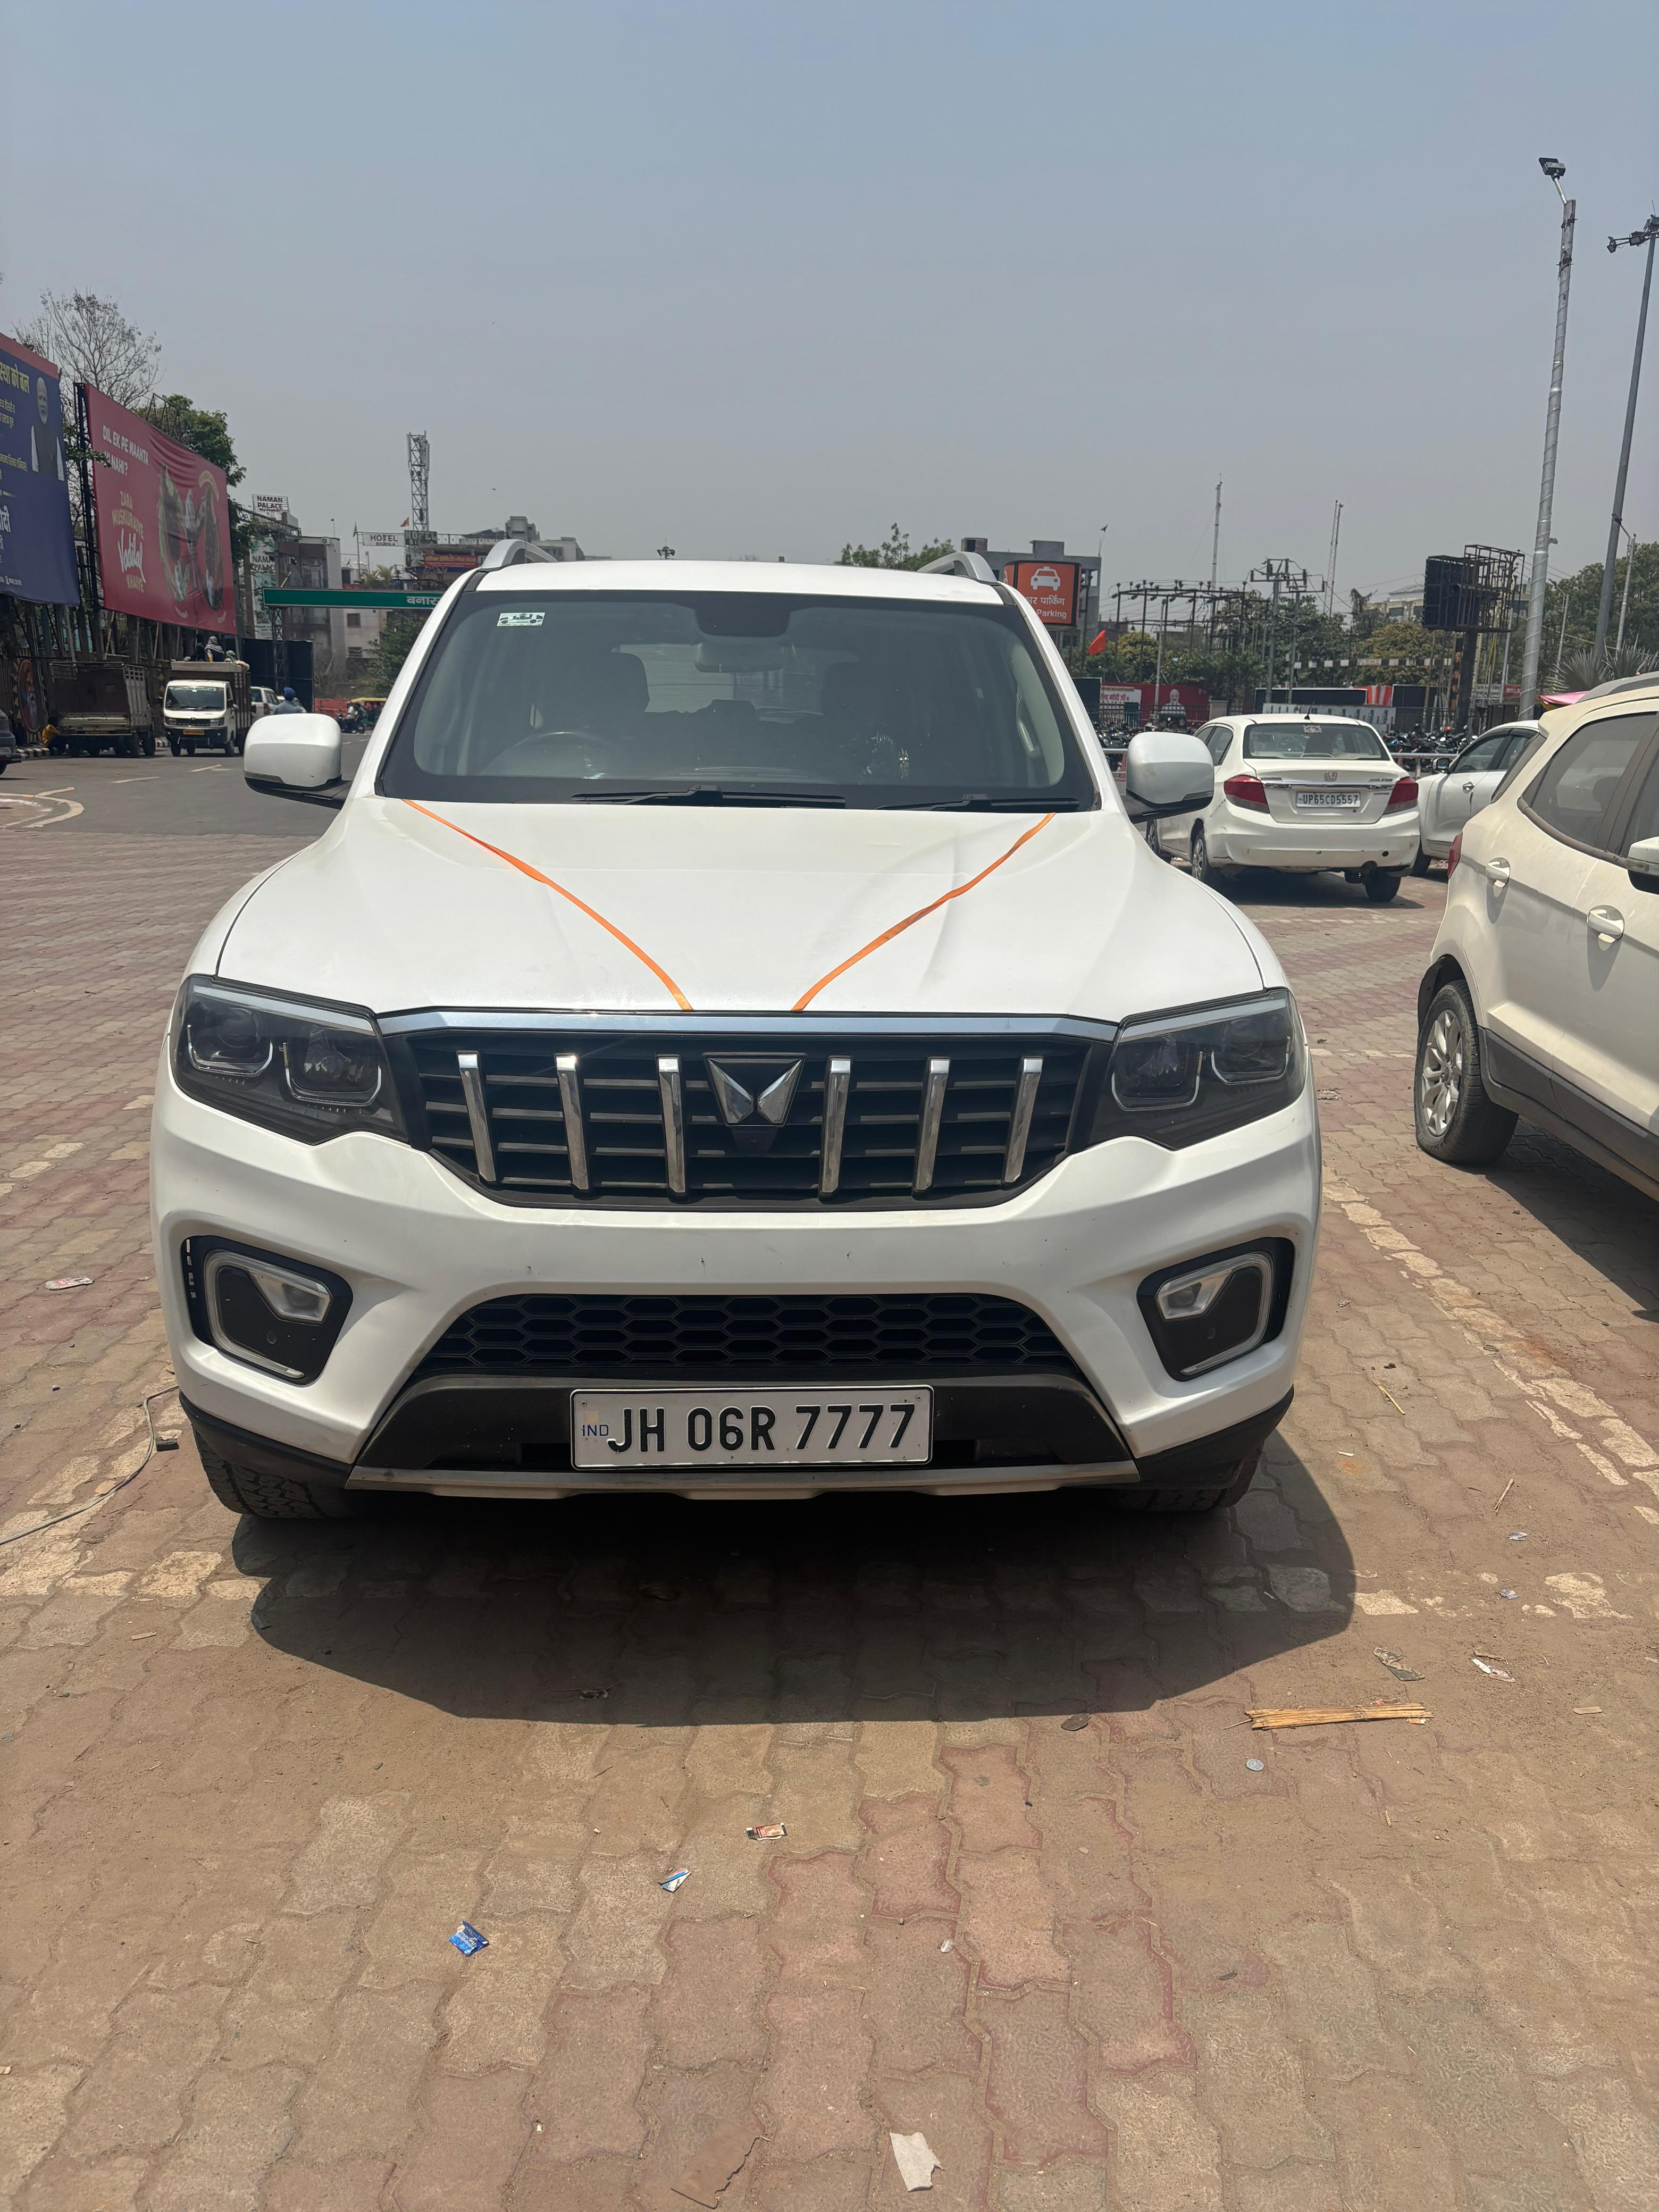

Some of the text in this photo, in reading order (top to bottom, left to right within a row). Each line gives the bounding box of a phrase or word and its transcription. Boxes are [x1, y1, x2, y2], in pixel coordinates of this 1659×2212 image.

[11, 363, 19, 389] को
[19, 372, 30, 394] बल
[103, 425, 149, 466] DIL EK PE MAANTA
[119, 490, 132, 509] ZARA
[0, 505, 11, 533] ोदी
[118, 528, 147, 583] Vadilal
[406, 596, 440, 605] बनार
[1040, 594, 1065, 606] पार्किंग
[1037, 609, 1067, 619] Parking
[1303, 794, 1358, 805] UP65CD5557
[583, 1404, 915, 1453] IND JH 06R 7777
